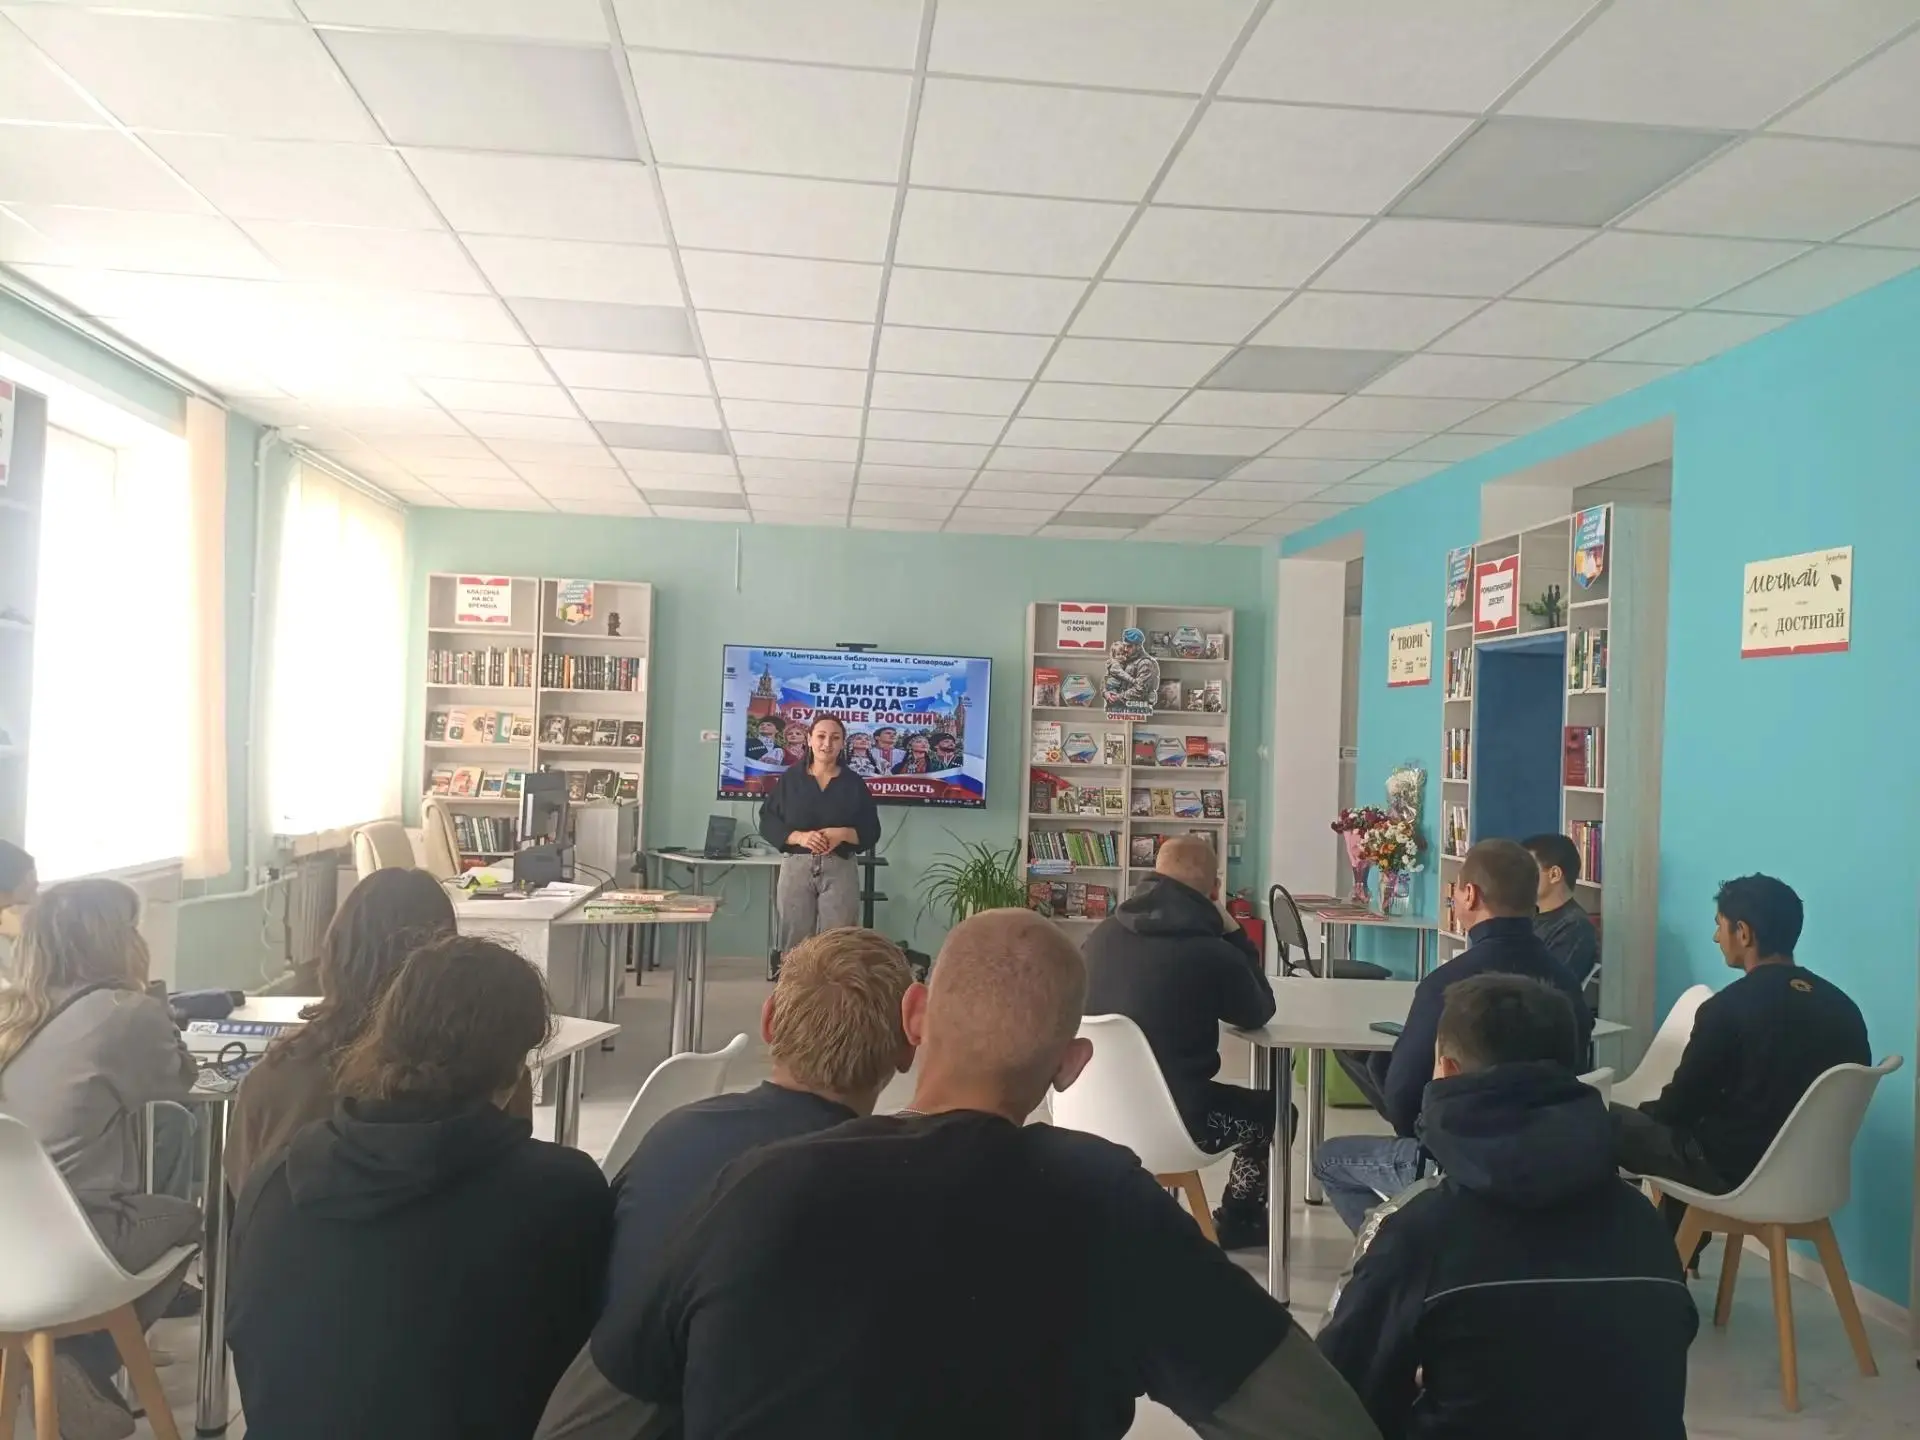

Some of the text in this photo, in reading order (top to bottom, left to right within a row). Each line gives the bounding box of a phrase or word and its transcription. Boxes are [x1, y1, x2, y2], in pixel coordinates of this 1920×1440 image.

[1397, 633, 1423, 650] ТВОРИ
[844, 654, 888, 663] библиотека
[809, 682, 919, 698] В ЕДИНСТВЕ
[816, 695, 902, 712] НАРОДА
[875, 712, 933, 725] РОССИИ
